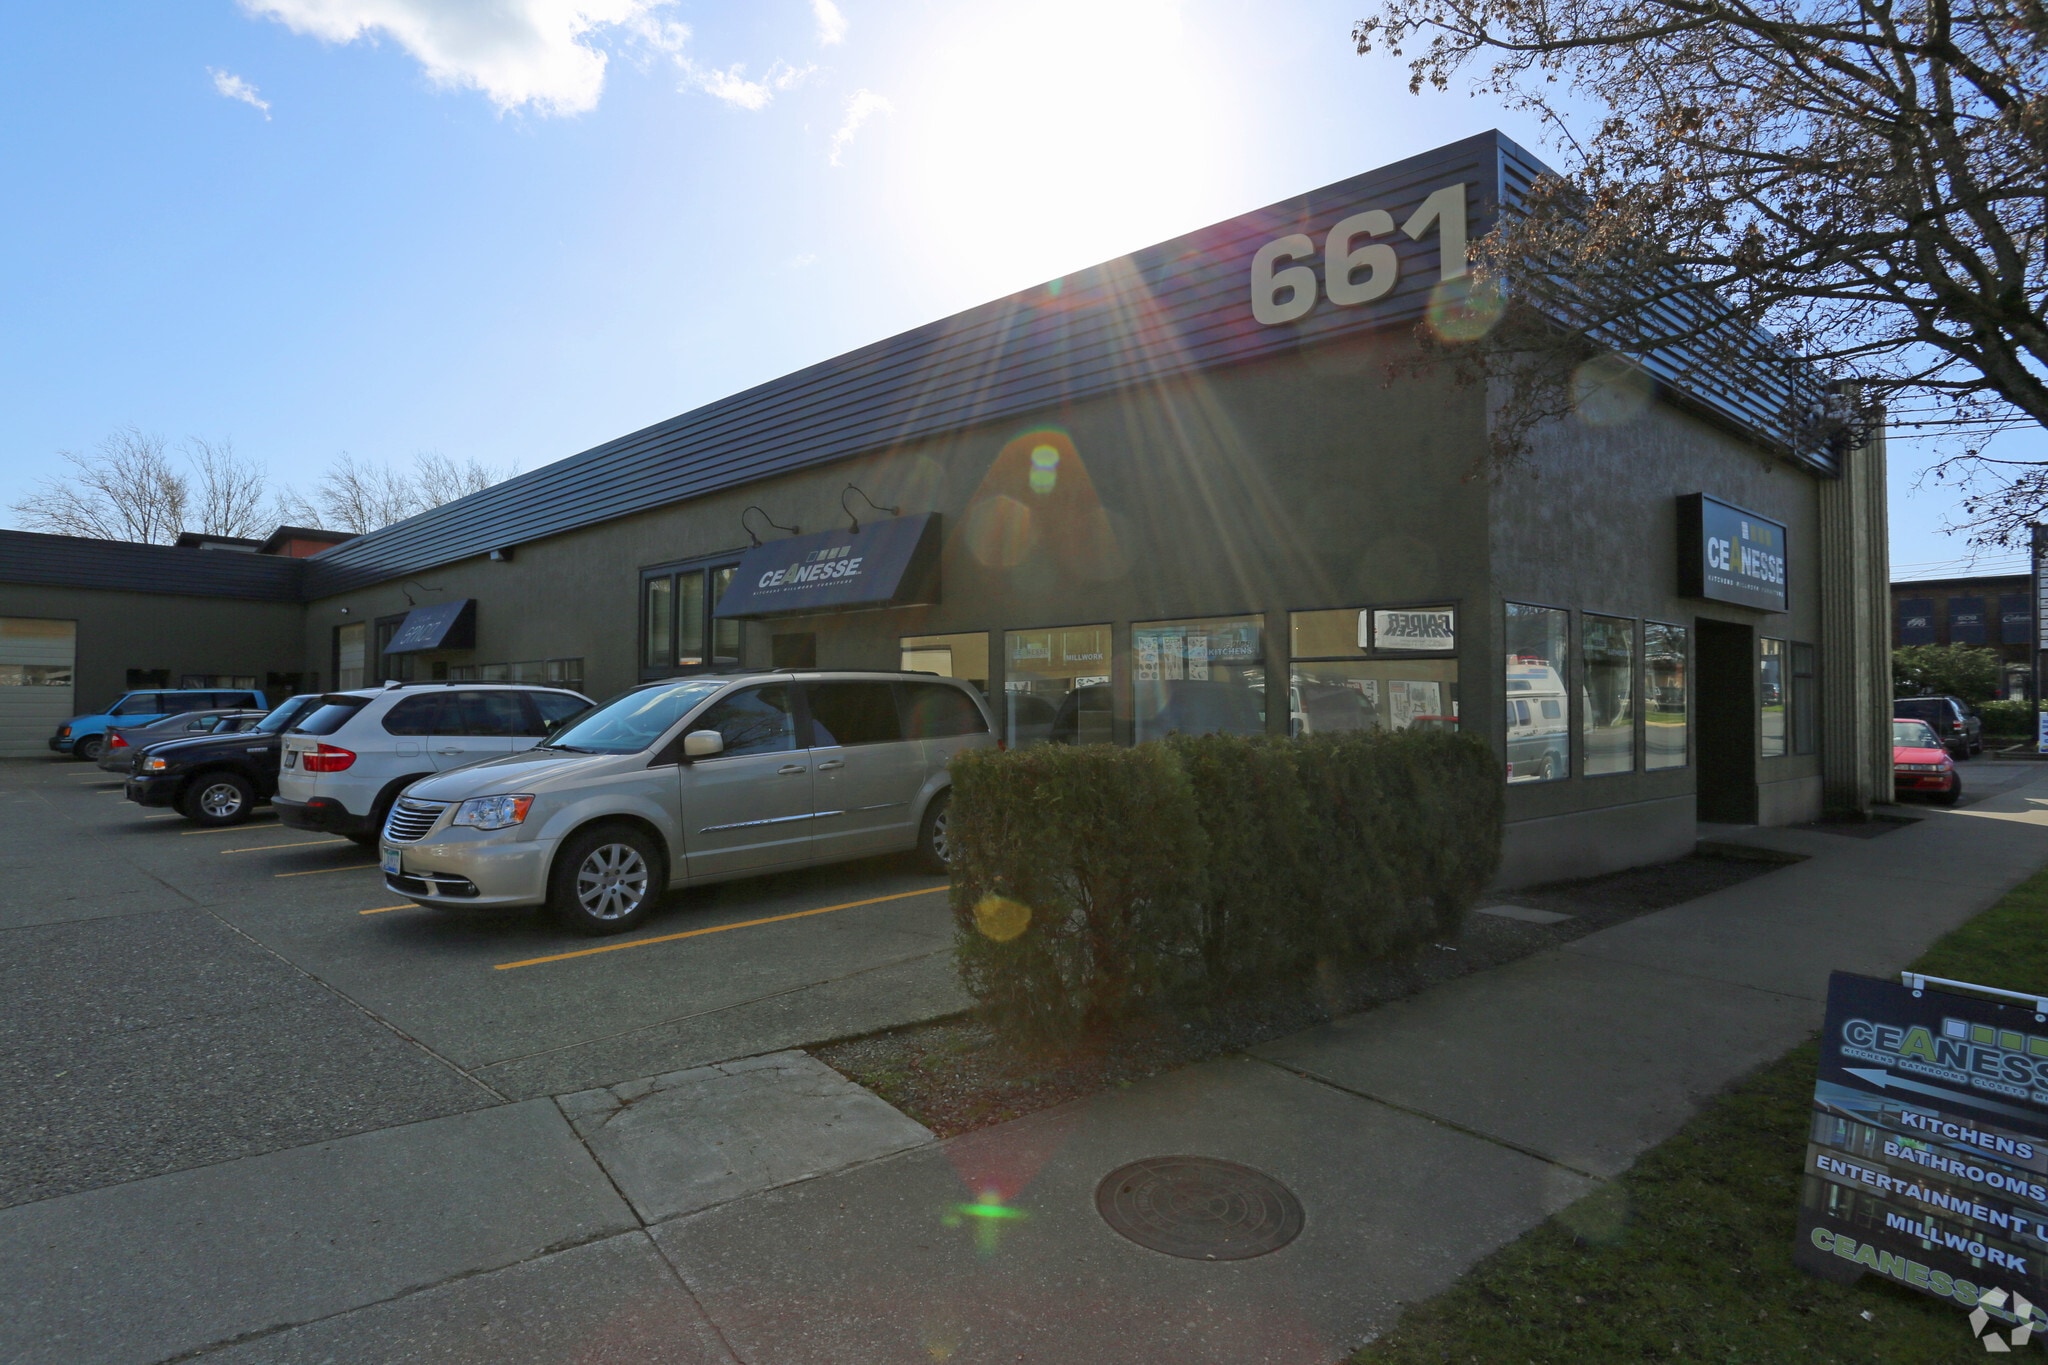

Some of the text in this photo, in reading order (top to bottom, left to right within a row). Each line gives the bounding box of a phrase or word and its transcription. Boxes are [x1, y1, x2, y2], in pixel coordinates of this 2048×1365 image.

[1251, 183, 1467, 325] 661
[758, 557, 863, 588] CEANESSE
[1708, 536, 1784, 585] CEANESSE
[1066, 653, 1104, 661] MILLWORK
[1208, 647, 1252, 656] KITCHENS
[1843, 1047, 1894, 1065] KITCHENS
[1901, 1061, 1966, 1082] BATHROOMS
[1974, 1079, 2026, 1097] CLOSETS
[1901, 1110, 2033, 1160] KITCHENS
[1816, 1154, 2028, 1233] ENTERTAINMENT
[1884, 1140, 2048, 1202] BATHROOMS
[1886, 1212, 2027, 1275] MILLWORK
